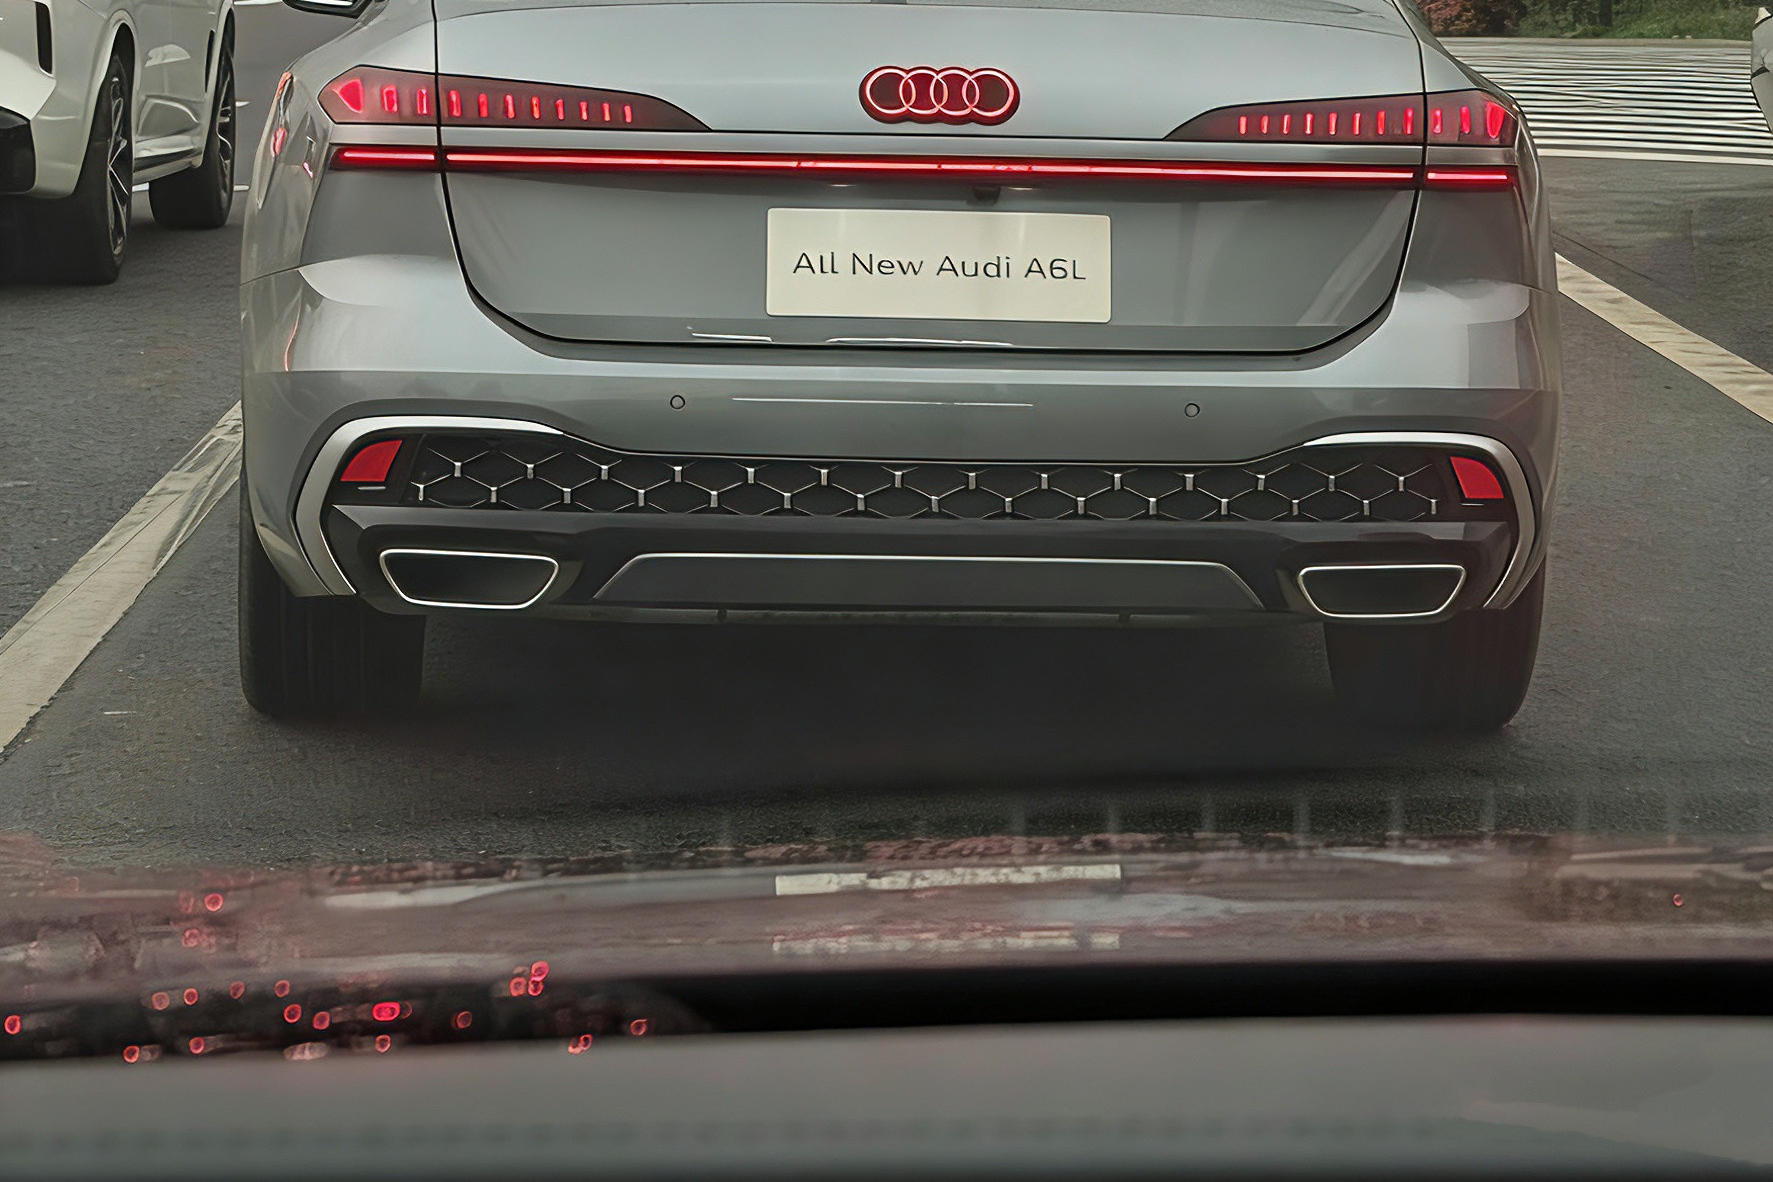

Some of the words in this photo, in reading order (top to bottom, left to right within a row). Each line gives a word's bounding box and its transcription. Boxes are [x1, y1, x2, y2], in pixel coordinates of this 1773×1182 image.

[792, 251, 839, 275] All
[852, 252, 924, 276] New
[936, 255, 1012, 279] Audi
[1024, 257, 1087, 280] A6L
